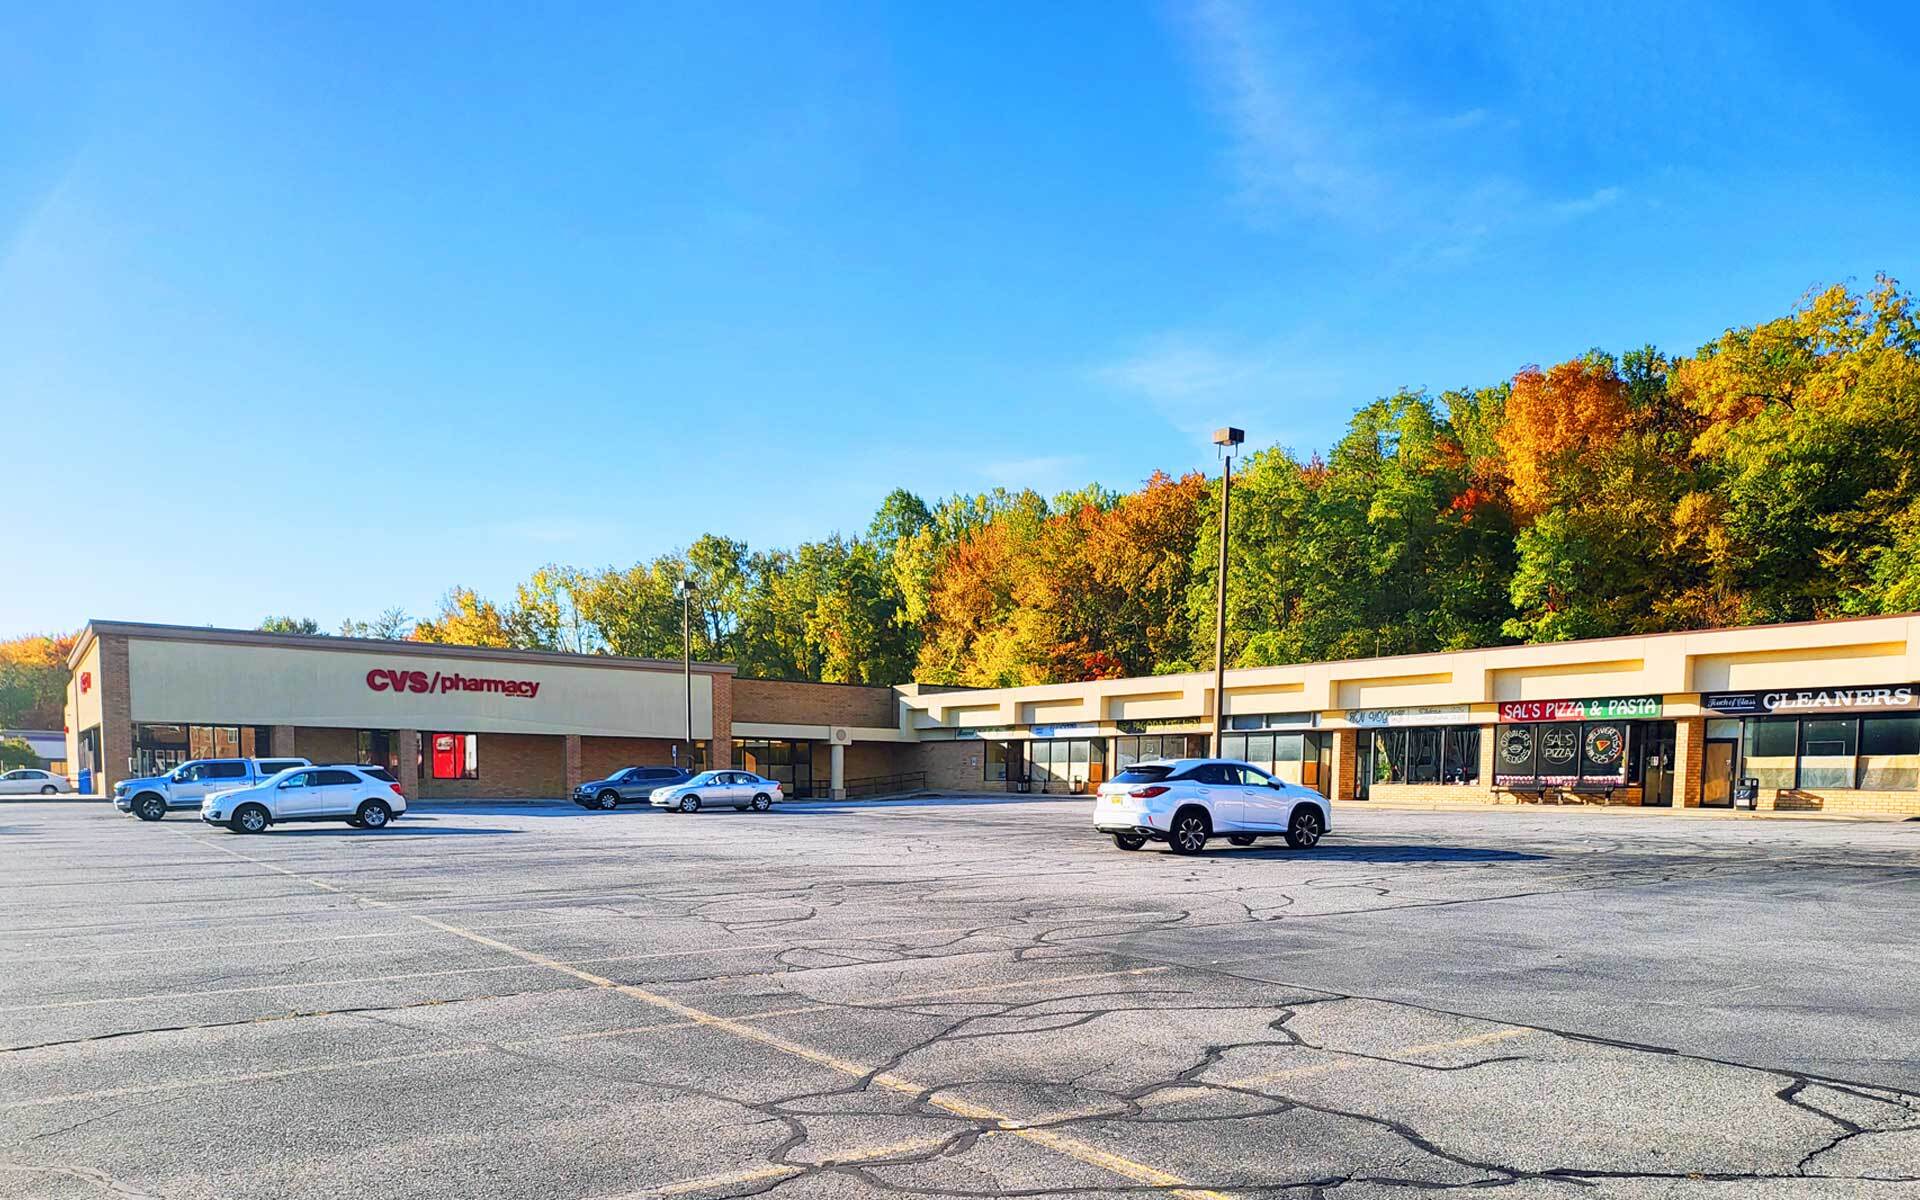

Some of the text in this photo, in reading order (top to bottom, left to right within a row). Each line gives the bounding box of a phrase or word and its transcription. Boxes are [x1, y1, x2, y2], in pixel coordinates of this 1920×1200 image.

[366, 669, 540, 698] CVS/pharmacy
[1504, 698, 1656, 718] SAL'S PIZZA & PASTA
[1763, 687, 1912, 710] CLEANERS
[1545, 748, 1572, 758] PIZZA
